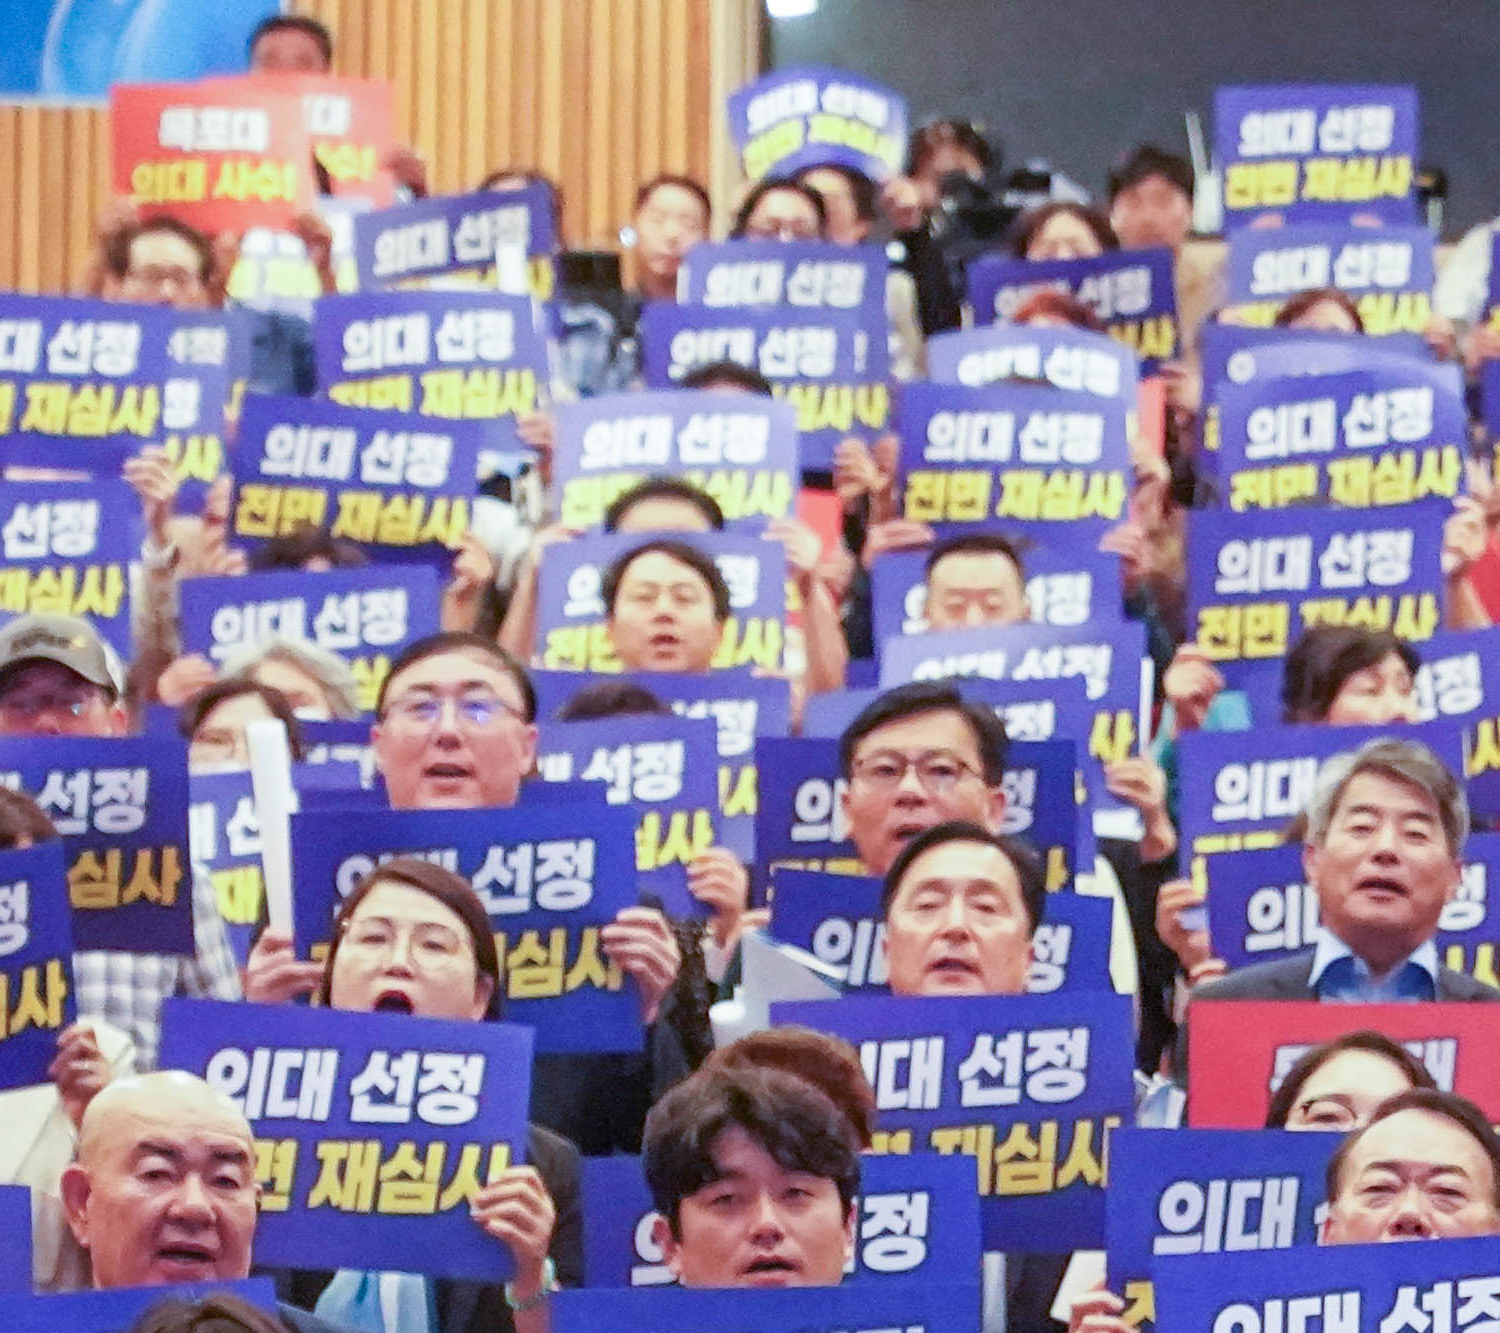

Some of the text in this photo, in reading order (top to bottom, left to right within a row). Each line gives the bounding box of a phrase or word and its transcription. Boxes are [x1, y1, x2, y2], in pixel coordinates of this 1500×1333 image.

[48, 322, 140, 375] 선정
[22, 385, 159, 435] 재심사
[925, 411, 1103, 463] 의대 선정
[1343, 386, 1433, 447] 선정
[261, 425, 452, 486] 의대 선정
[3, 501, 99, 558] 선정
[334, 493, 474, 554] 재심사
[1319, 531, 1413, 588] 선정
[197, 1048, 484, 1132] 의대 선정
[959, 1028, 1089, 1106] 선정
[1154, 1177, 1298, 1255] 의대
